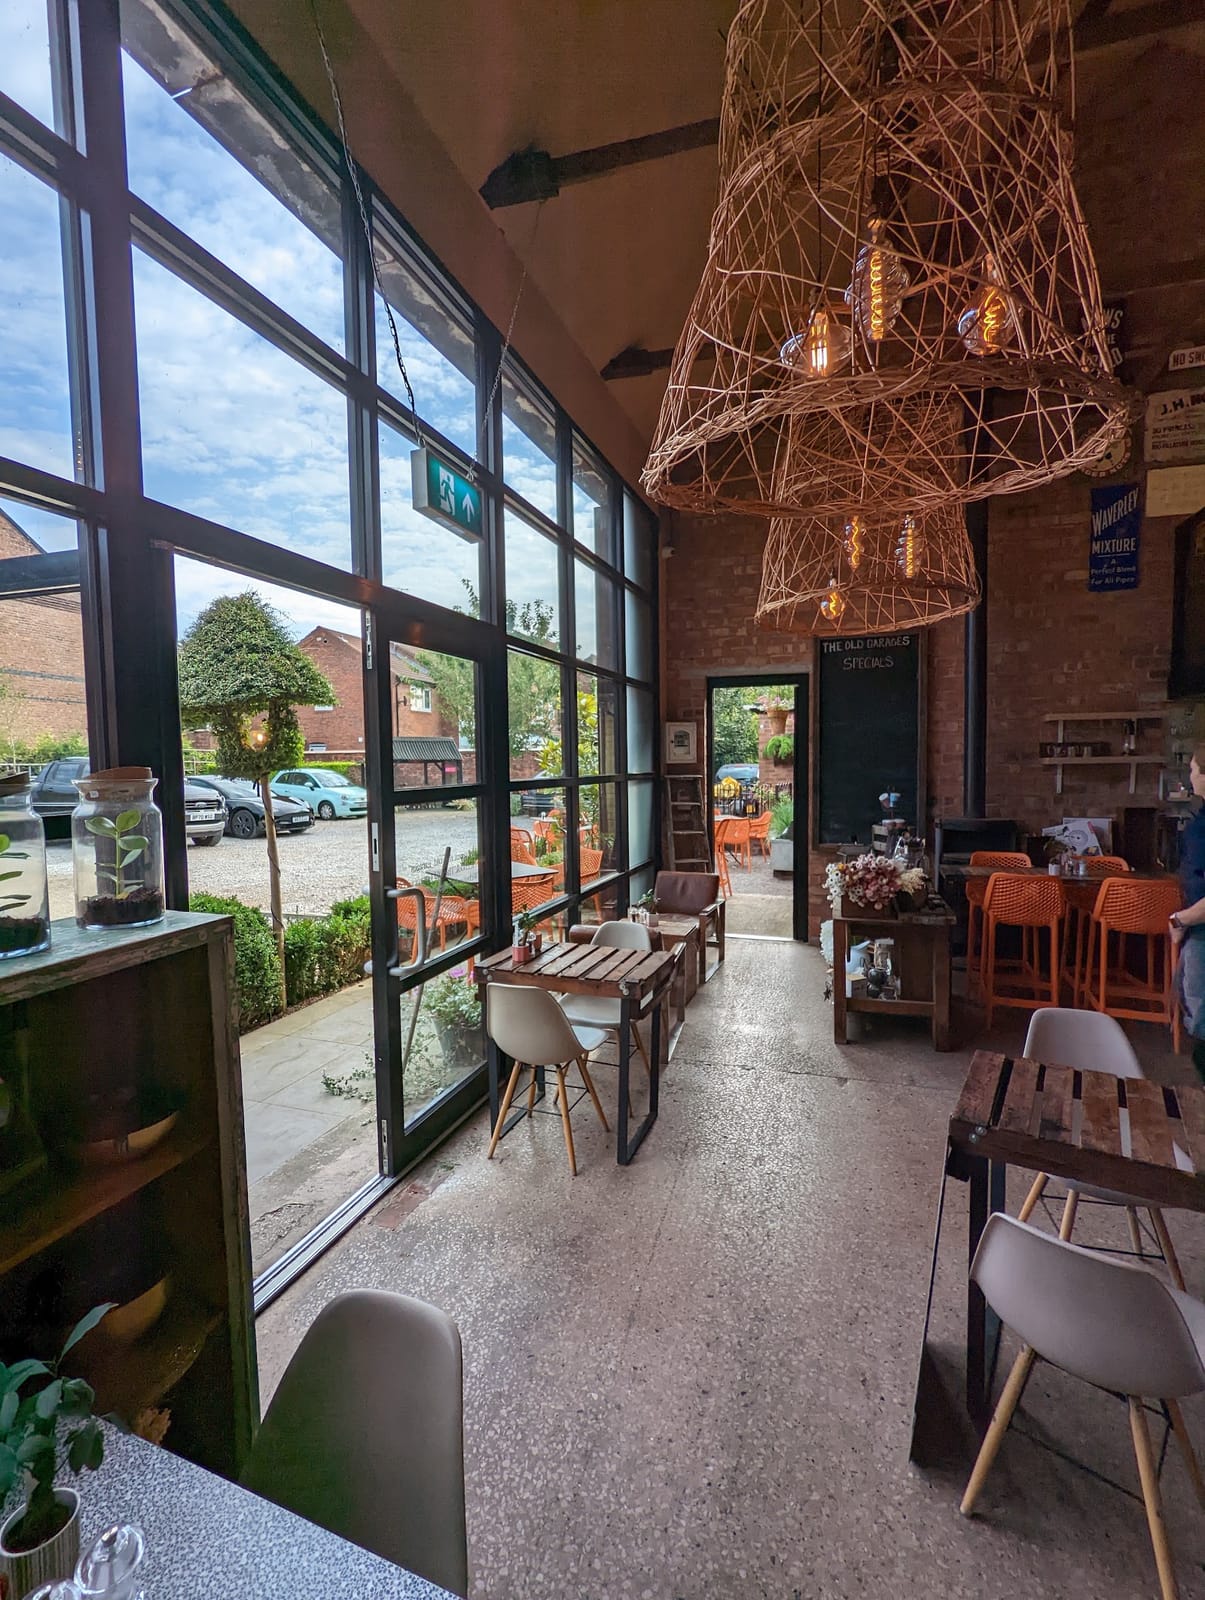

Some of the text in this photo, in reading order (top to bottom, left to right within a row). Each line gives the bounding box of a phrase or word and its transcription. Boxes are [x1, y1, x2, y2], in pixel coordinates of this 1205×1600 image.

[1173, 352, 1186, 367] NO
[1092, 487, 1139, 537] WAVERLEY
[1092, 538, 1137, 554] MIXTURE
[822, 636, 911, 653] THE OLD GARAGES
[842, 655, 894, 670] SPECIALS
